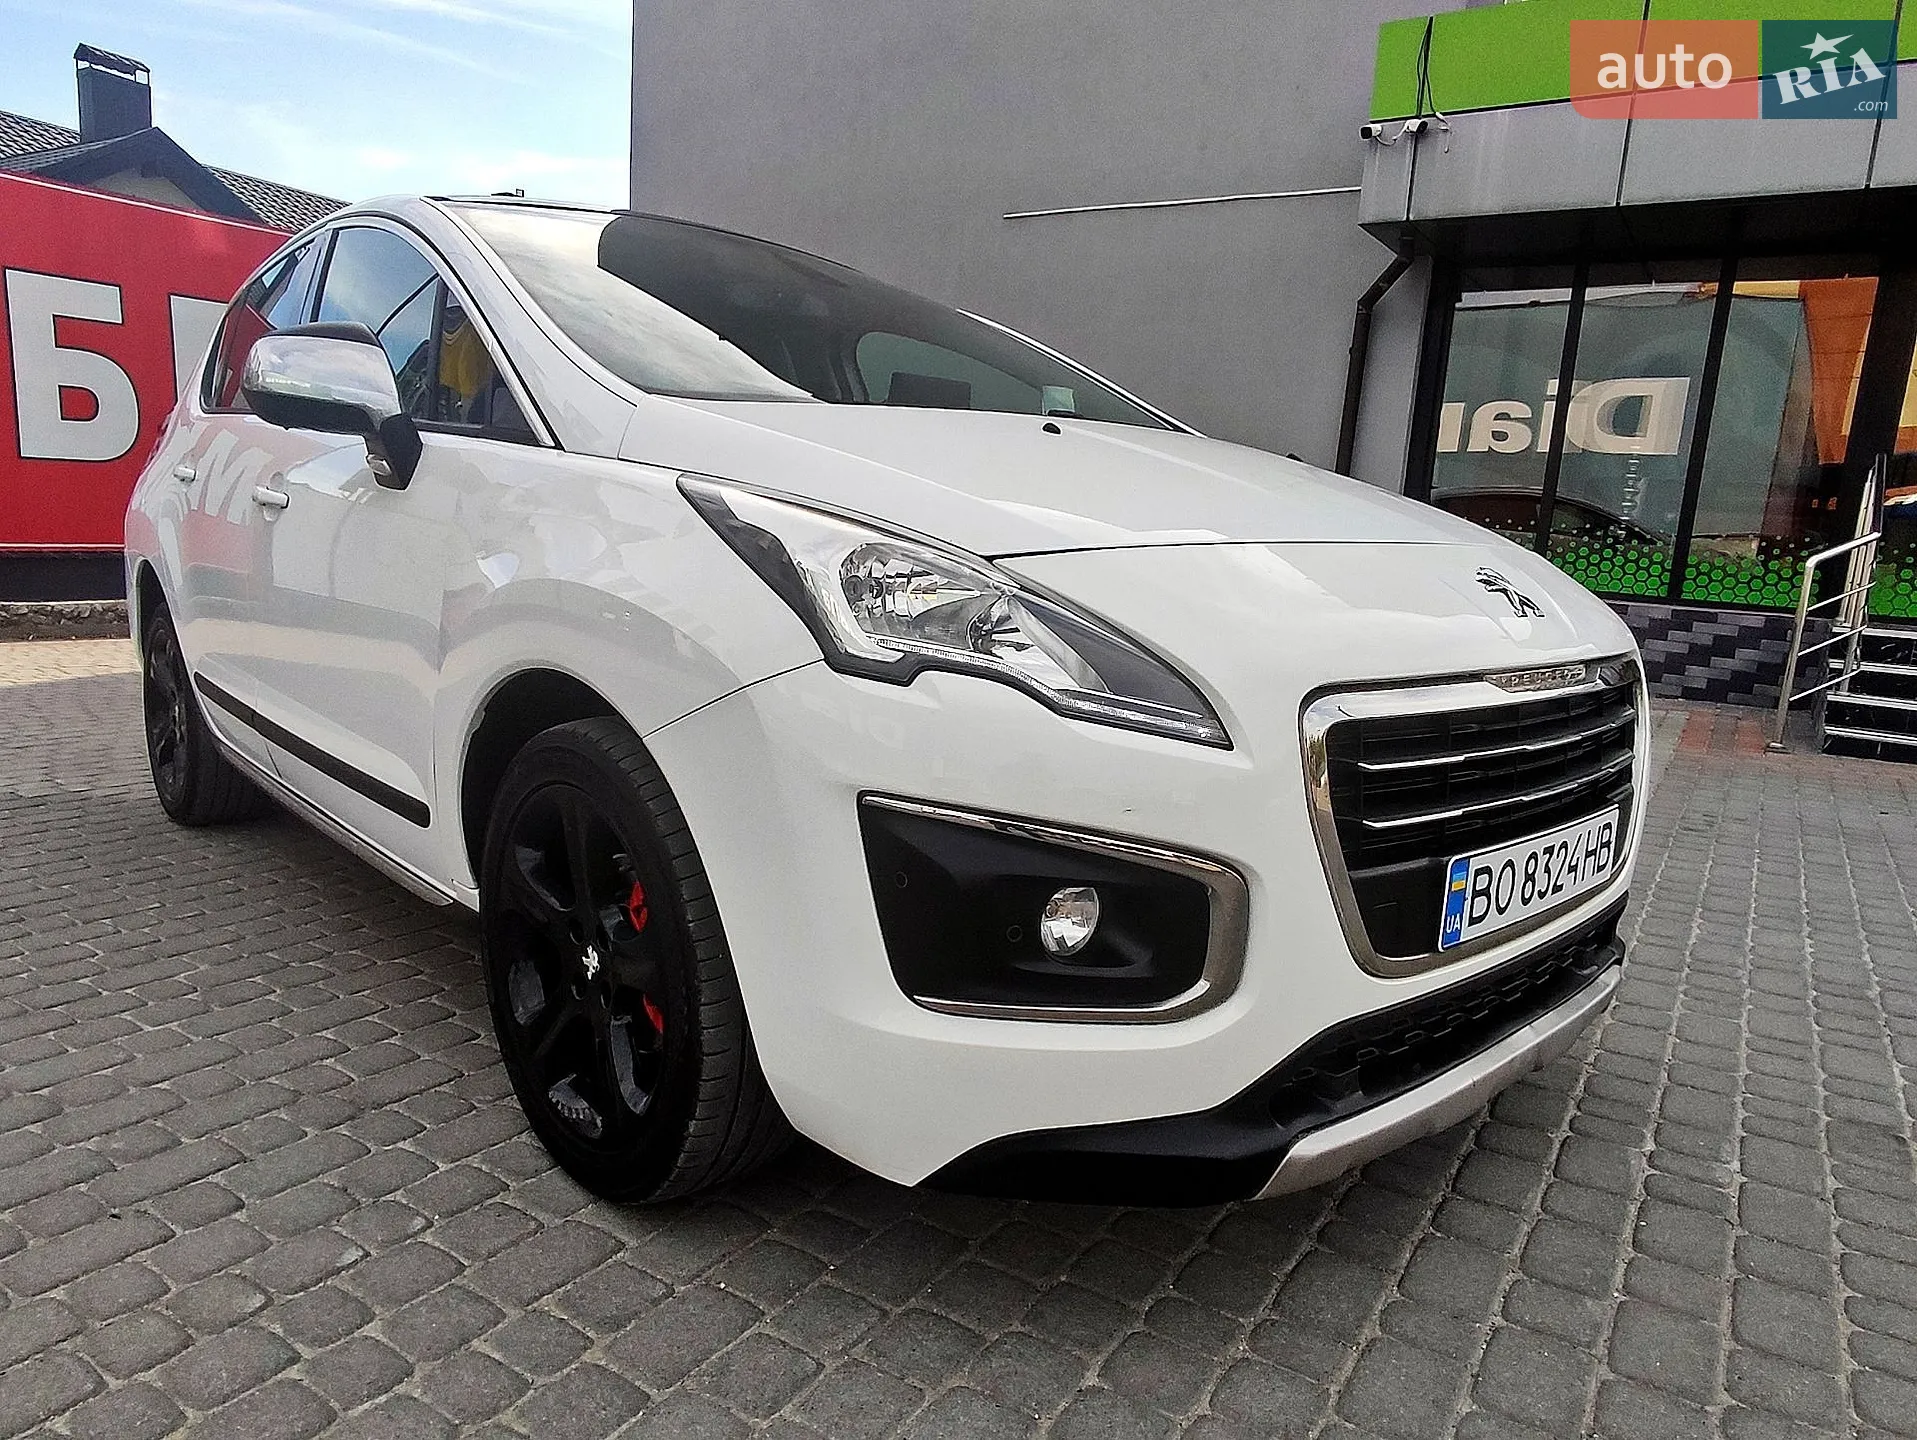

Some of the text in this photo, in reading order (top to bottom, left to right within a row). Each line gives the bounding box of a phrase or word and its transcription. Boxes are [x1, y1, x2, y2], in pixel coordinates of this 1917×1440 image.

[1467, 858, 1516, 927] BO
[1520, 832, 1583, 907] 8324
[1446, 915, 1462, 934] UA
